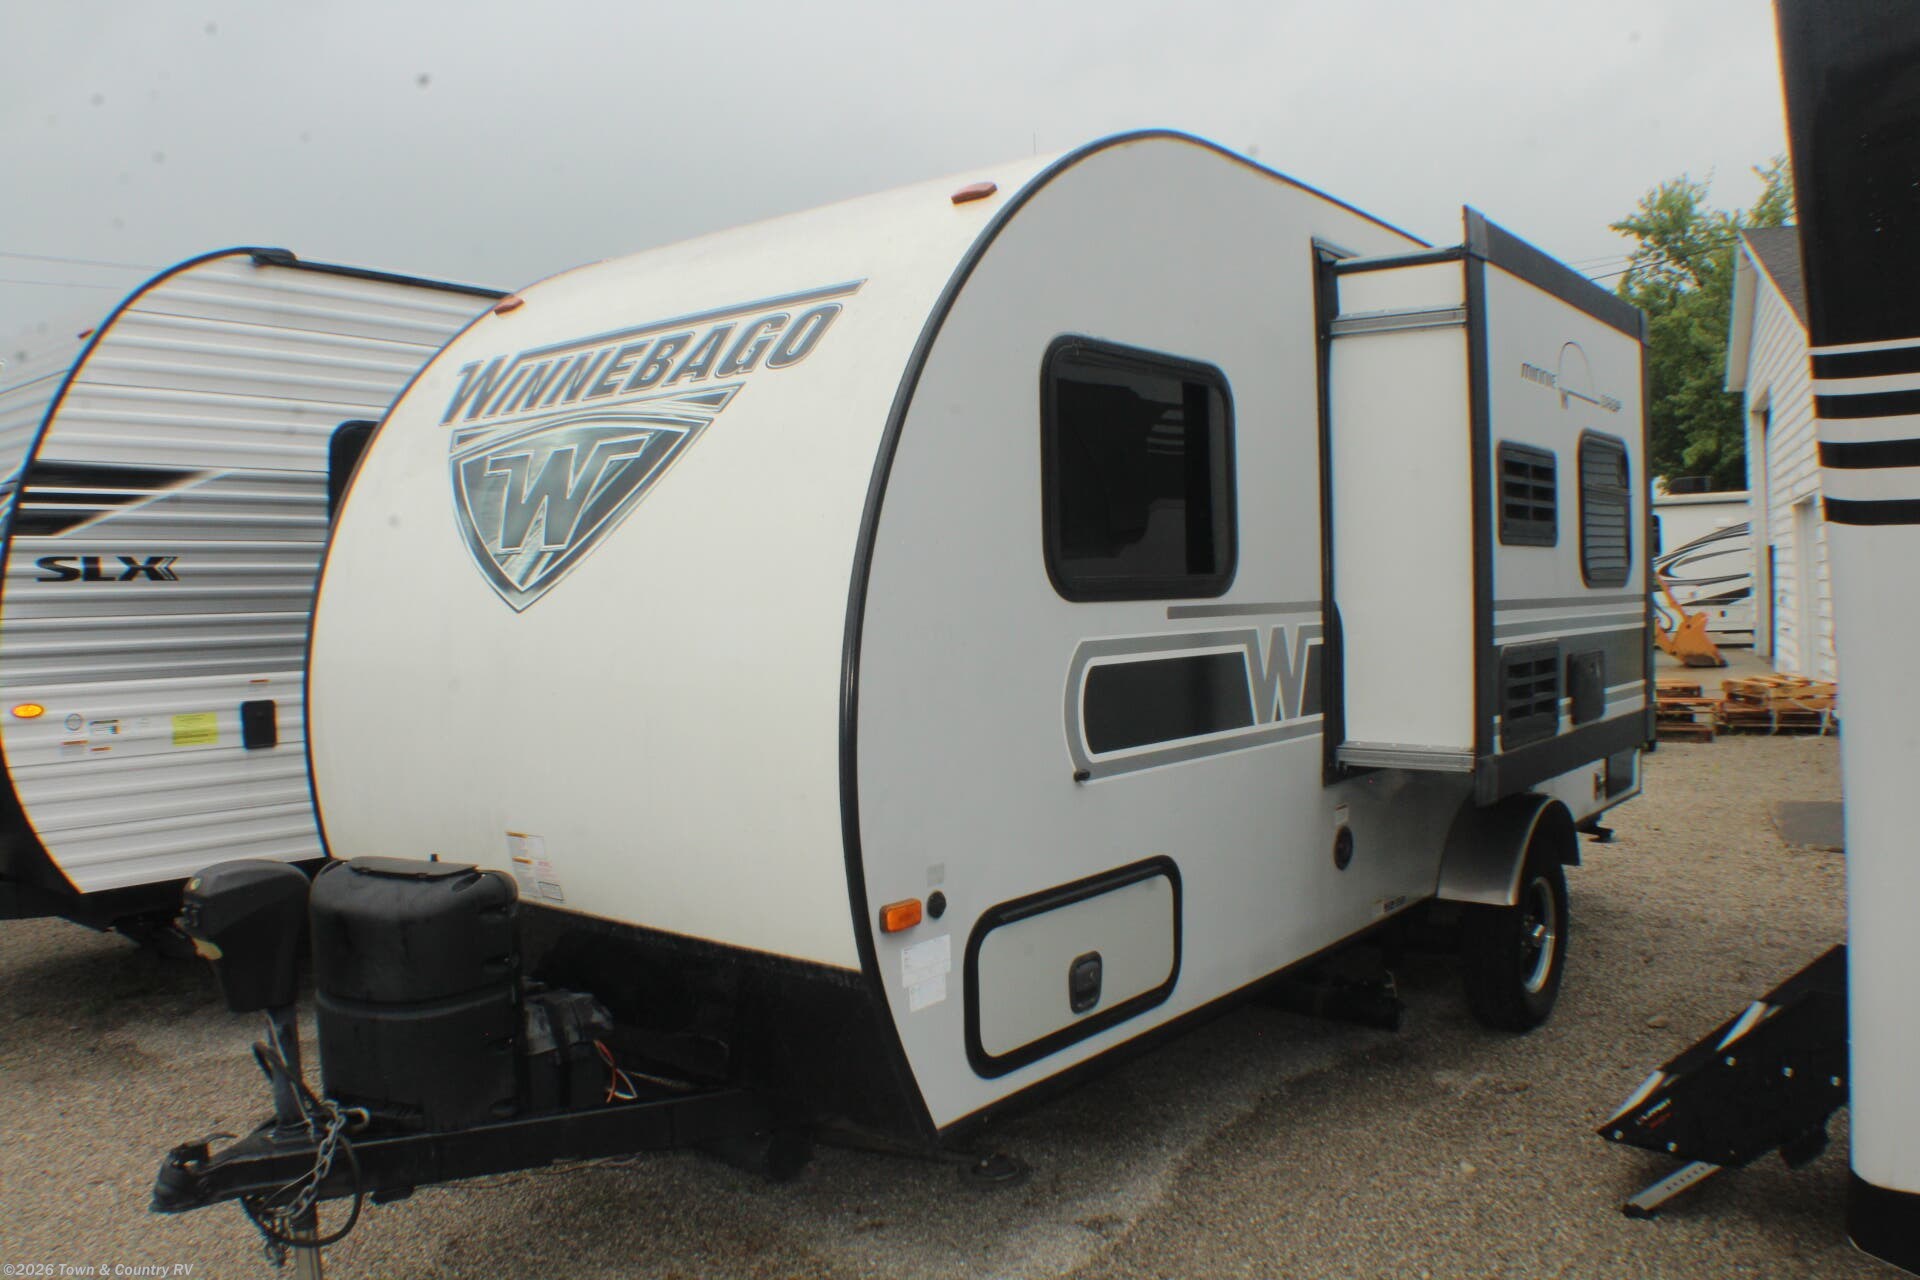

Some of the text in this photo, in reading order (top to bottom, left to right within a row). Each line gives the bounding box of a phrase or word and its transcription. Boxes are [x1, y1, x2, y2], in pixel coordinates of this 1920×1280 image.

[438, 302, 843, 426] WINNEBAGO
[484, 432, 655, 556] W
[35, 556, 179, 582] SLX
